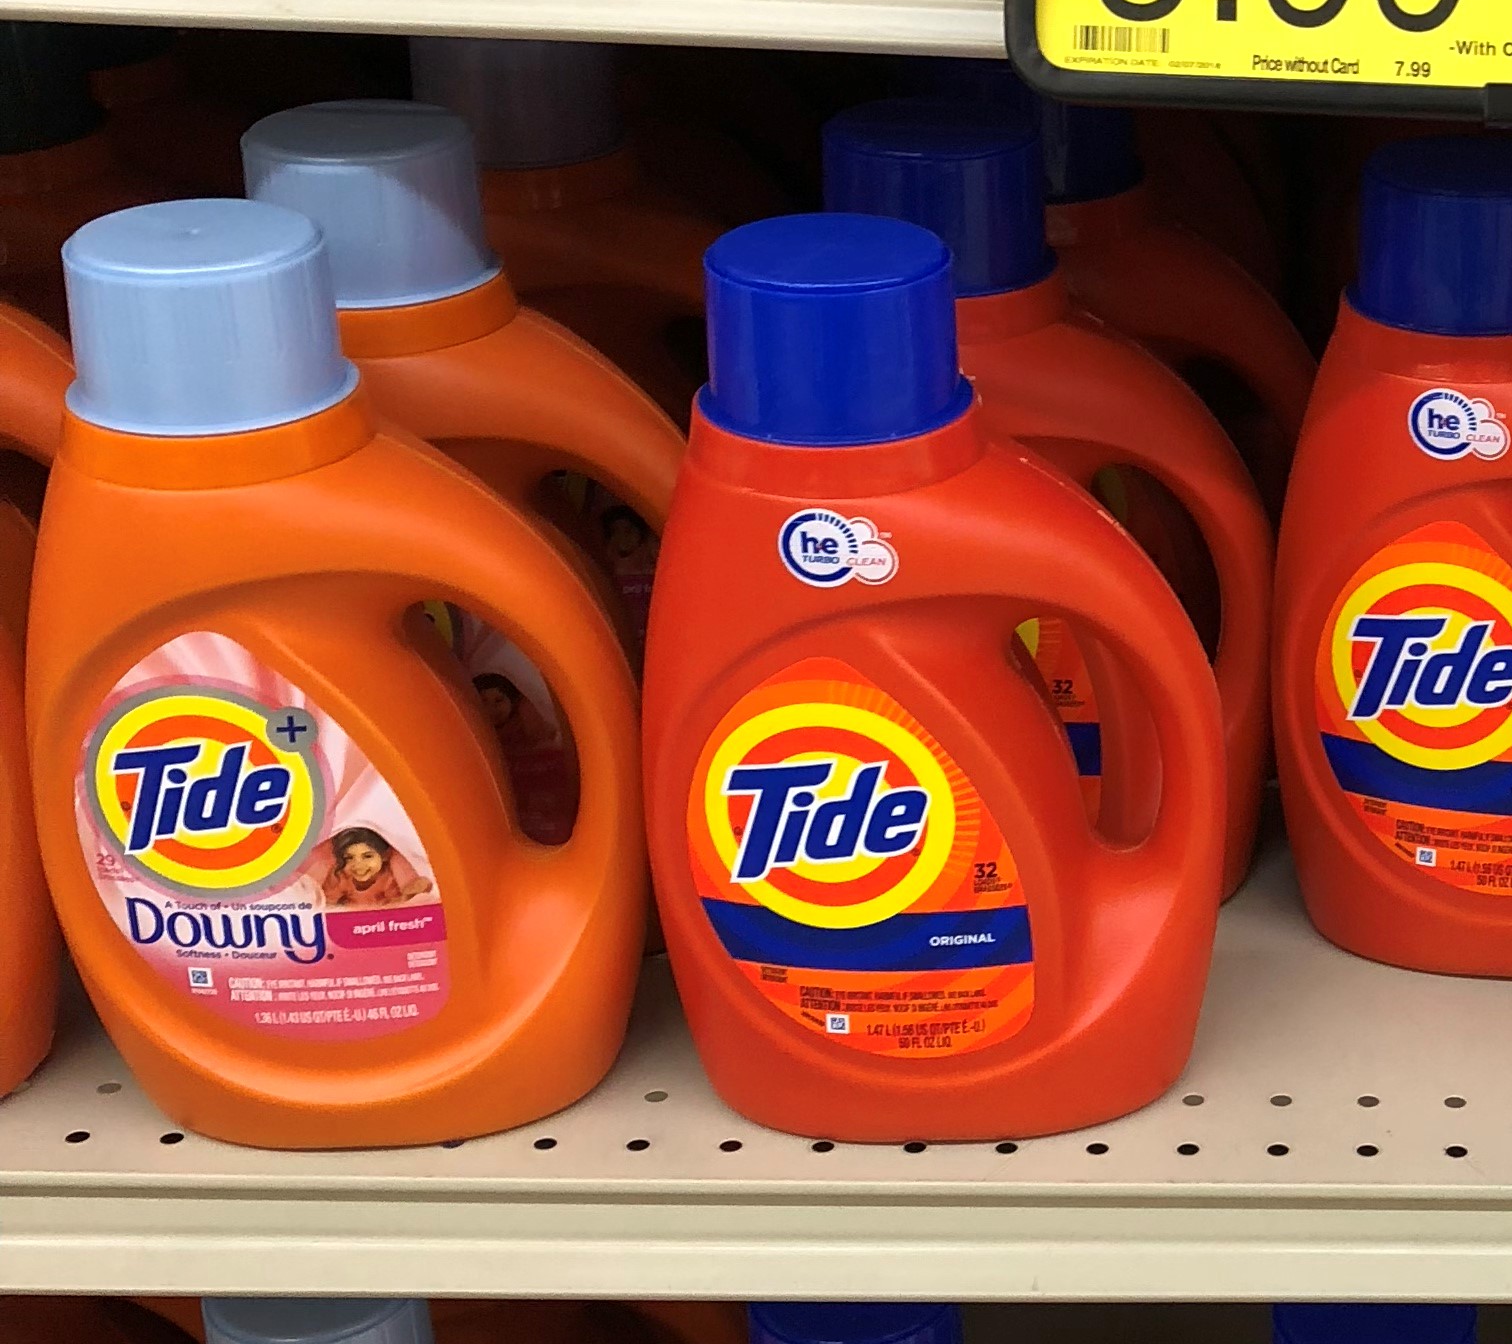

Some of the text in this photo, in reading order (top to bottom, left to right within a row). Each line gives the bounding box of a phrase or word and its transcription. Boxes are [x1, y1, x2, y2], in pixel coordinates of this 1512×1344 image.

[1252, 55, 1360, 75] Price without Card
[1395, 61, 1431, 78] 7.99
[1428, 408, 1459, 430] he
[1427, 429, 1501, 444] TURBO CLEAN
[800, 531, 838, 555] he
[802, 554, 886, 567] TURBO CLEAN
[1052, 679, 1073, 695] 32
[113, 739, 291, 855] Tide
[722, 759, 930, 884] Tide
[974, 861, 998, 878] 32
[124, 896, 326, 965] Downy
[352, 921, 385, 936] april
[929, 933, 995, 946] ORIGINAL
